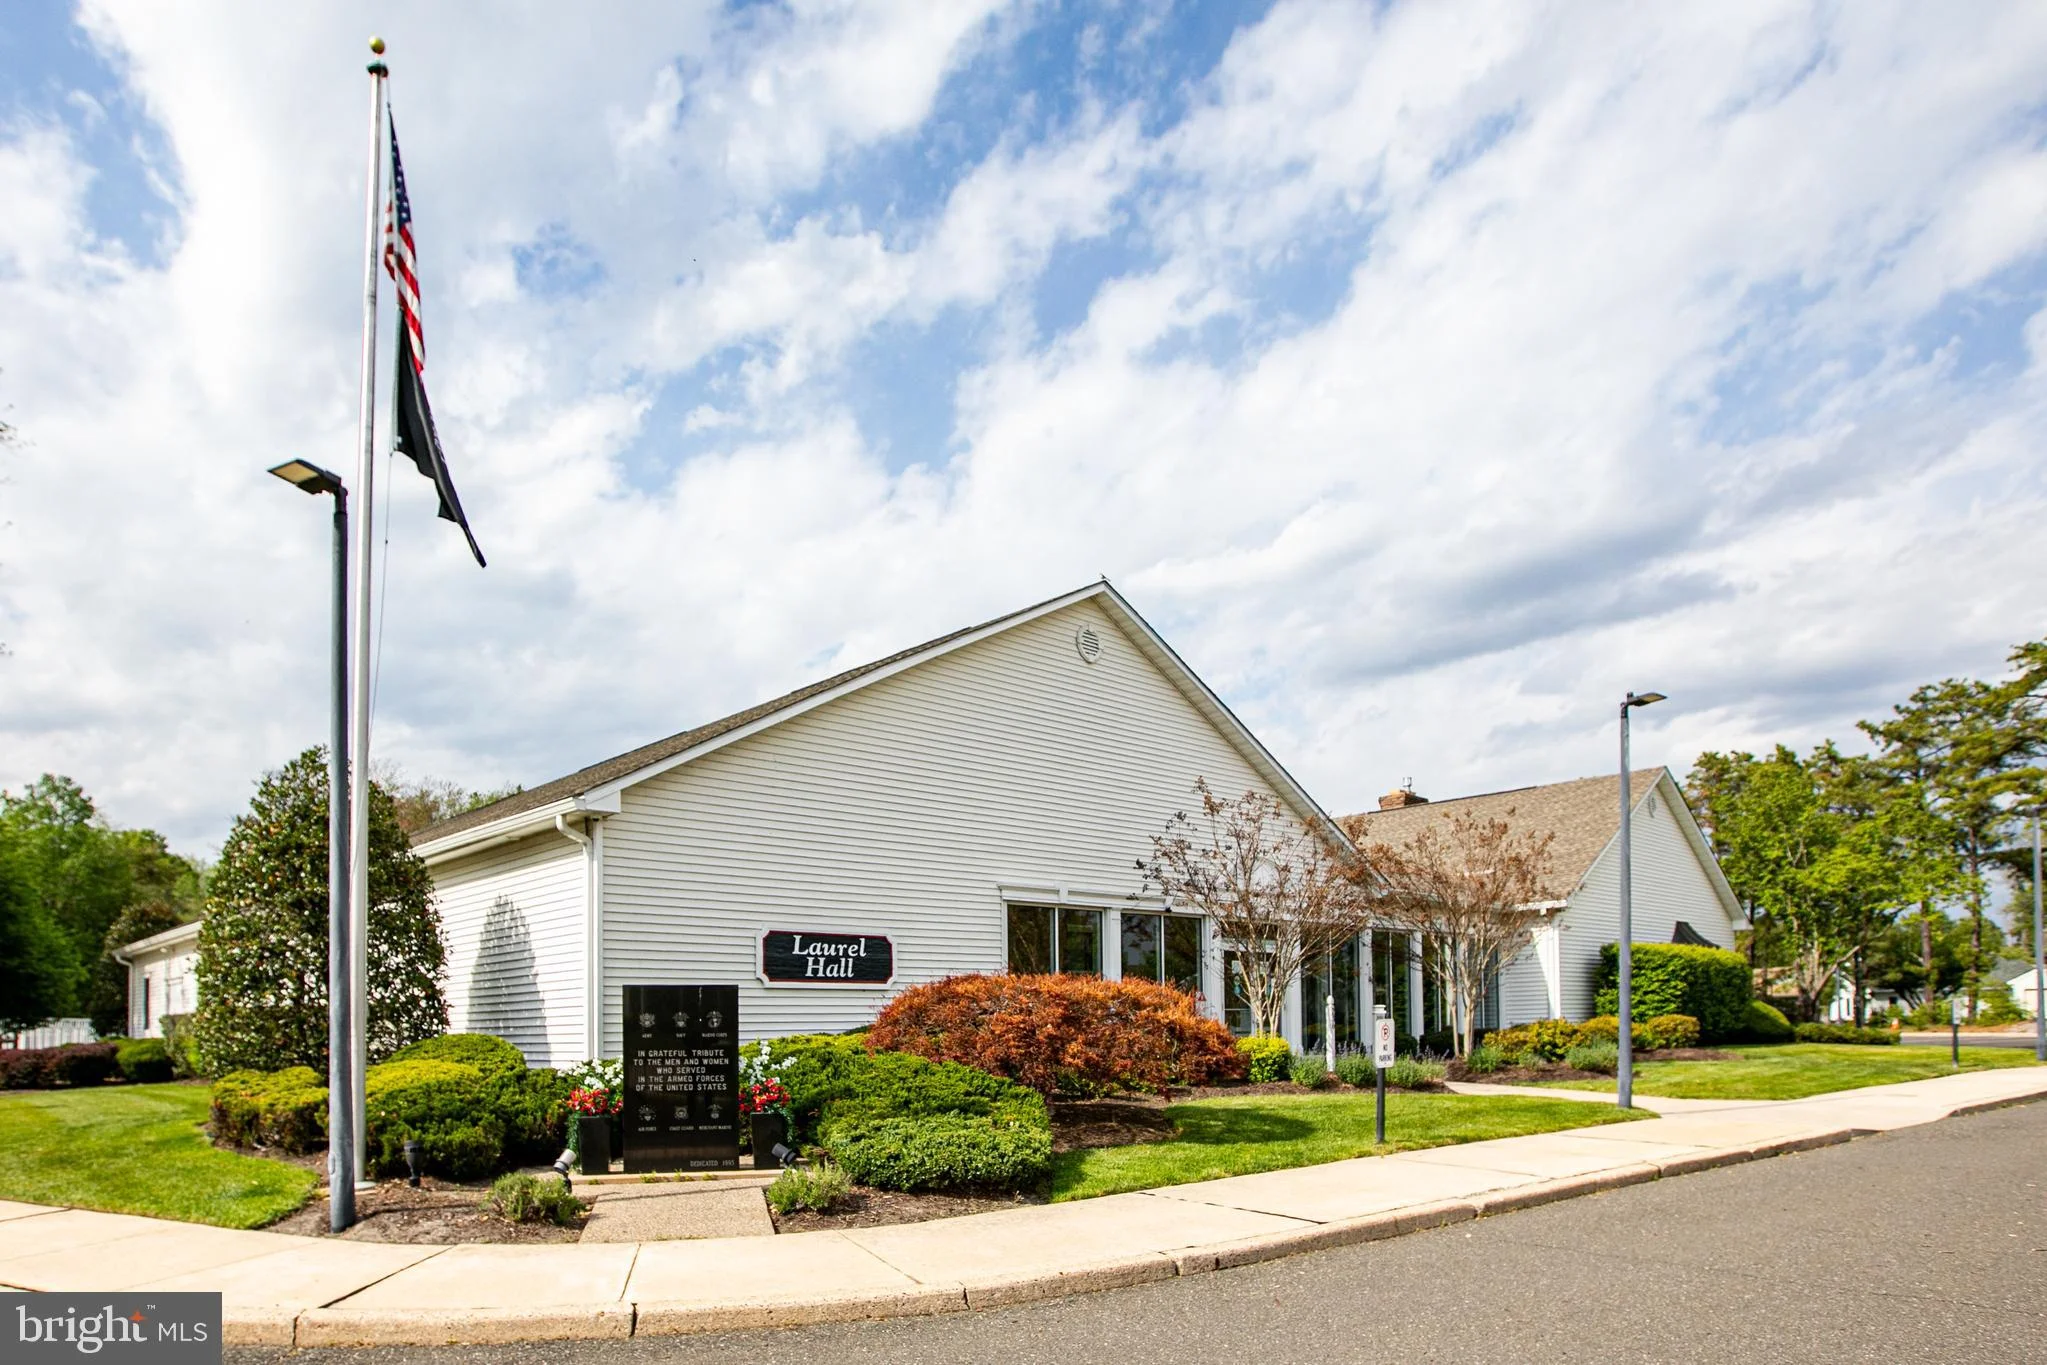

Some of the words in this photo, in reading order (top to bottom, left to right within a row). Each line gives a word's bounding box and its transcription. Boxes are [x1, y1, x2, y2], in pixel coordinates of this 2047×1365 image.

[792, 935, 867, 957] Laurel
[805, 957, 855, 978] Hall
[648, 1049, 687, 1057] GRATEFUL
[692, 1049, 725, 1057] TRIBUTE
[697, 1083, 727, 1091] STATES
